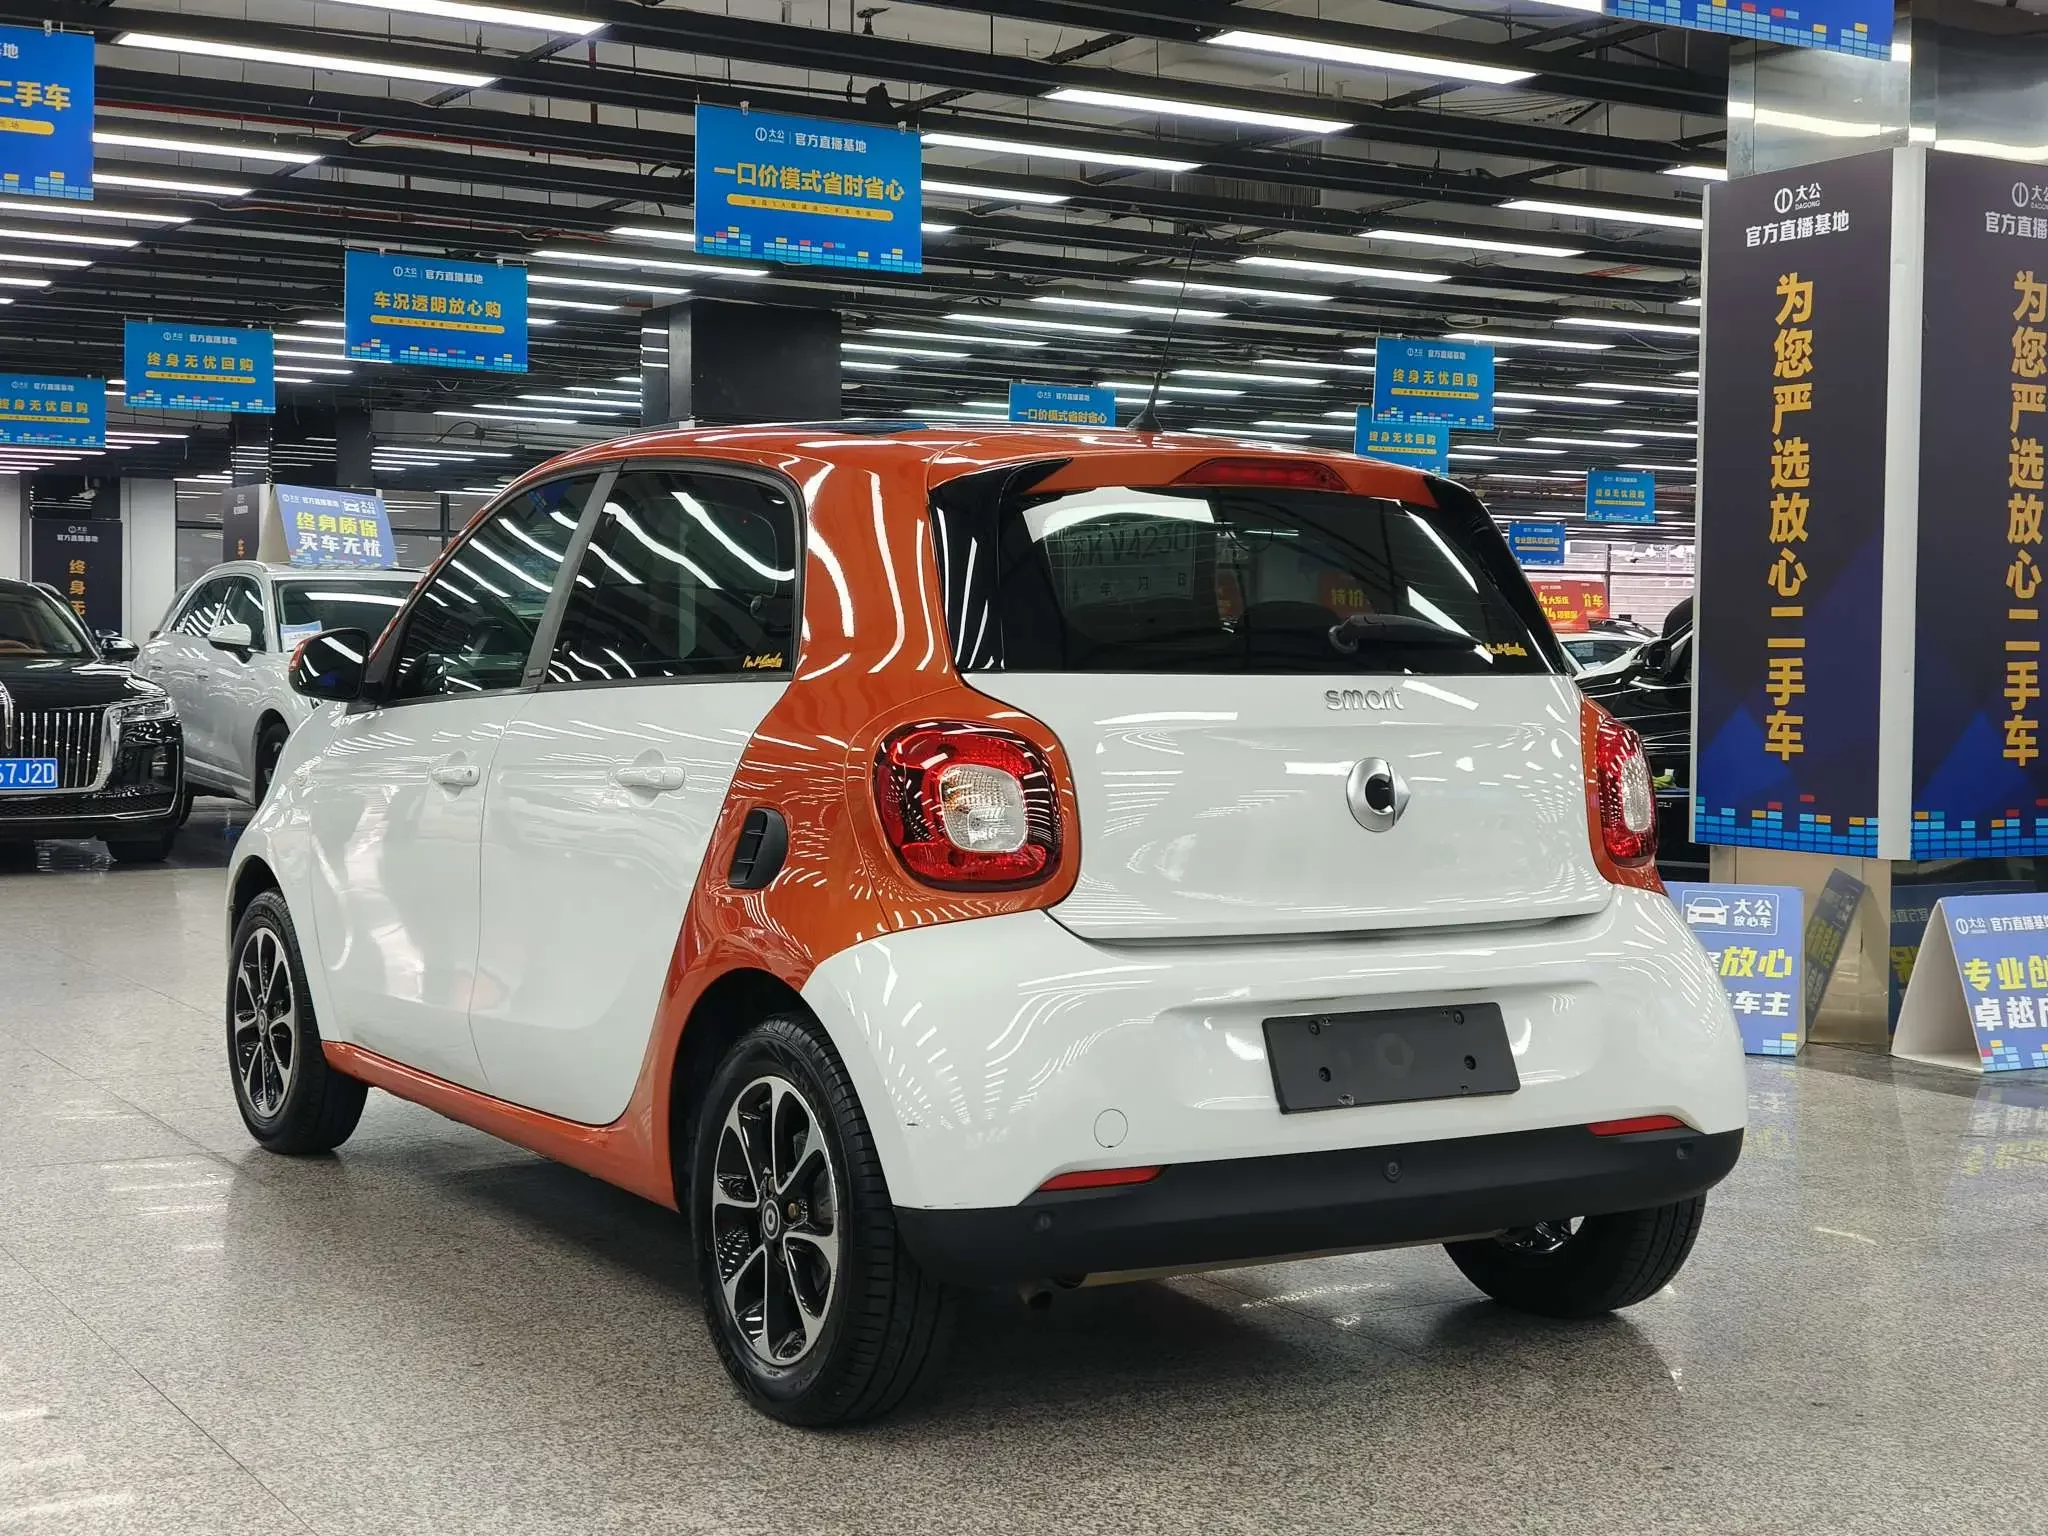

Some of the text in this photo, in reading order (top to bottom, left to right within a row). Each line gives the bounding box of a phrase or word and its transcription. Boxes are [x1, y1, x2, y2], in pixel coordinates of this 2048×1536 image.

[768, 129, 867, 154] 大公 官方直播基地
[714, 162, 905, 201] 一口价模式省时省心
[1795, 182, 1822, 201] 大公
[1746, 210, 1850, 248] 官方直播基地
[1985, 211, 2048, 240] 官方直播
[425, 269, 484, 285] 官方直播基地
[374, 291, 502, 319] 车况透明放心购
[147, 352, 254, 372] 终身无忧回购
[1392, 368, 1479, 388] 终身无忧回购
[1017, 408, 1107, 424] 一口价模式省时省心
[296, 511, 378, 538] 终身质保
[1765, 272, 1814, 761] 为您严选放心二手车
[2003, 270, 2048, 767] 为您严选放心二手车
[298, 531, 383, 558] 买车无忧
[1324, 685, 1404, 712] smart
[1733, 898, 1773, 917] 大公
[1733, 915, 1773, 929] 放心车
[1968, 917, 1986, 929] 大公
[1726, 990, 1792, 1017] 车主
